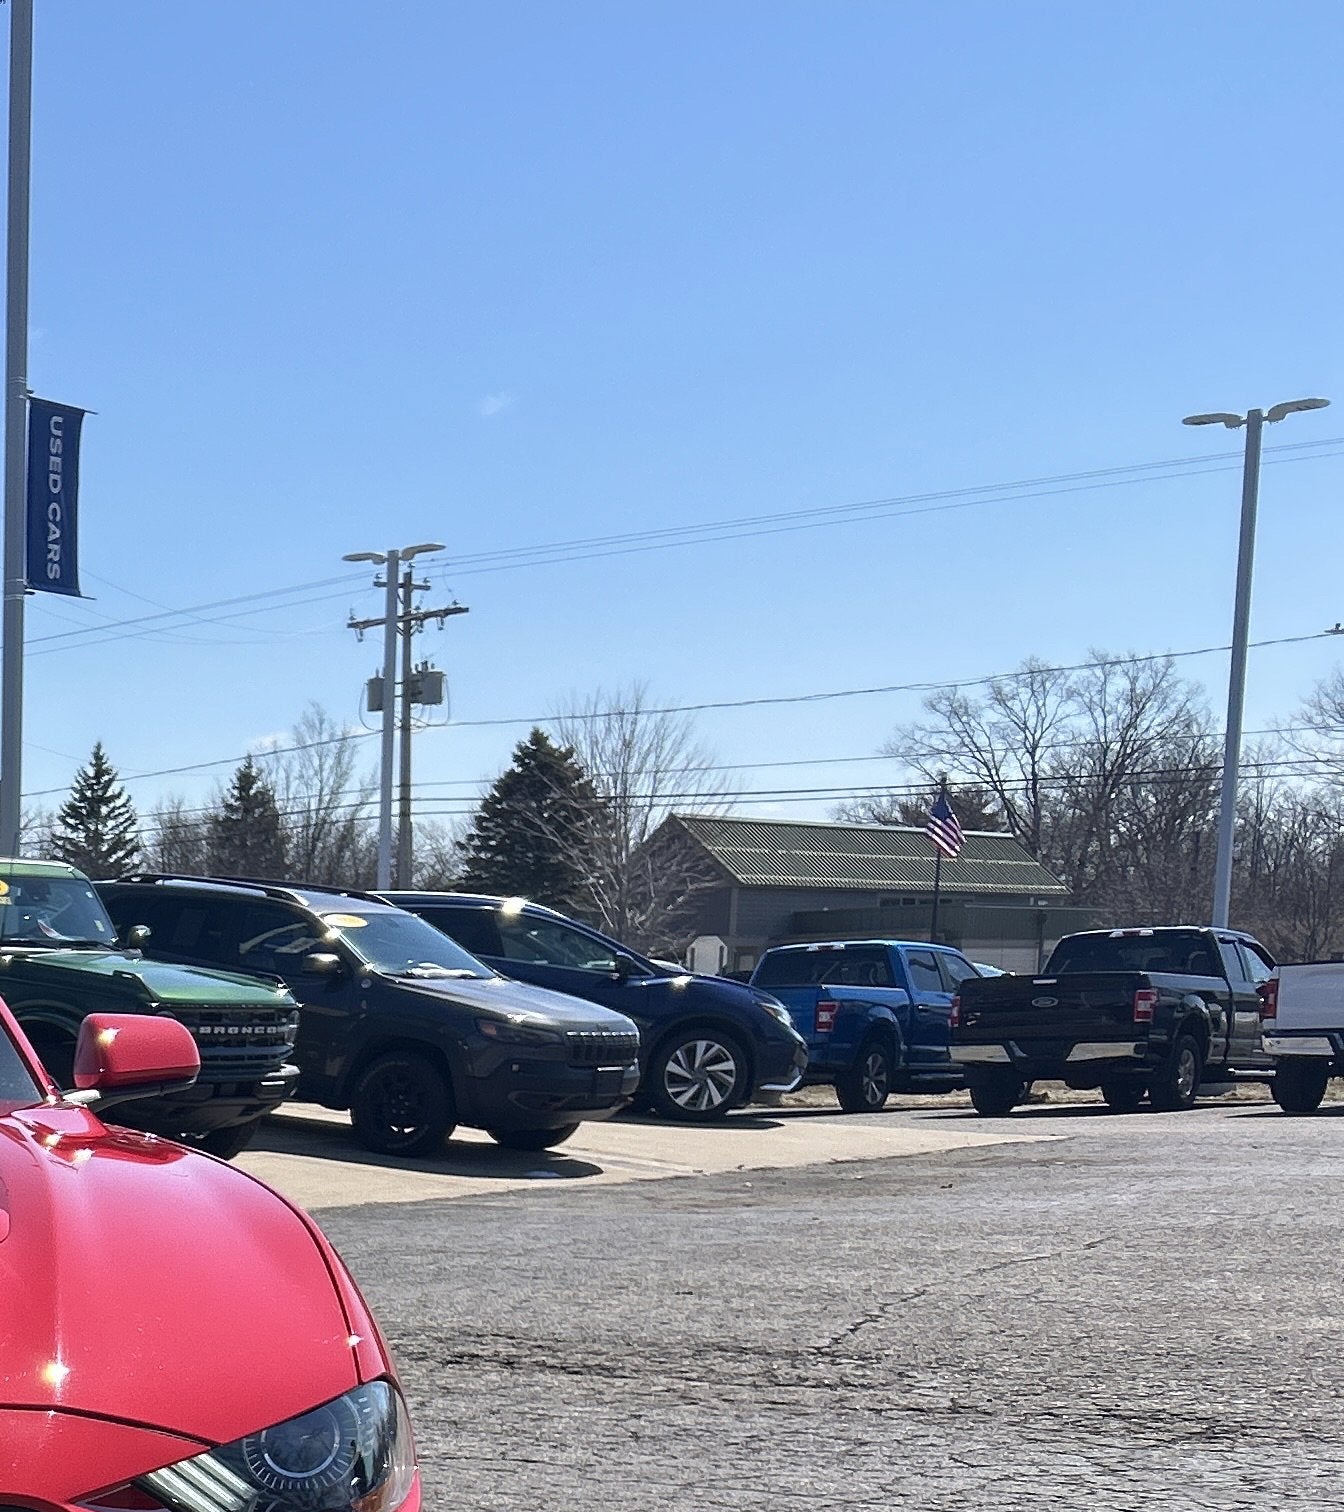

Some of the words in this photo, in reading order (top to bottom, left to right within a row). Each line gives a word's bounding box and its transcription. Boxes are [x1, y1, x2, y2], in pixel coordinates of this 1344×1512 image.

[47, 415, 64, 494] USED
[47, 502, 62, 580] CARS
[199, 1026, 277, 1034] BRONCO
